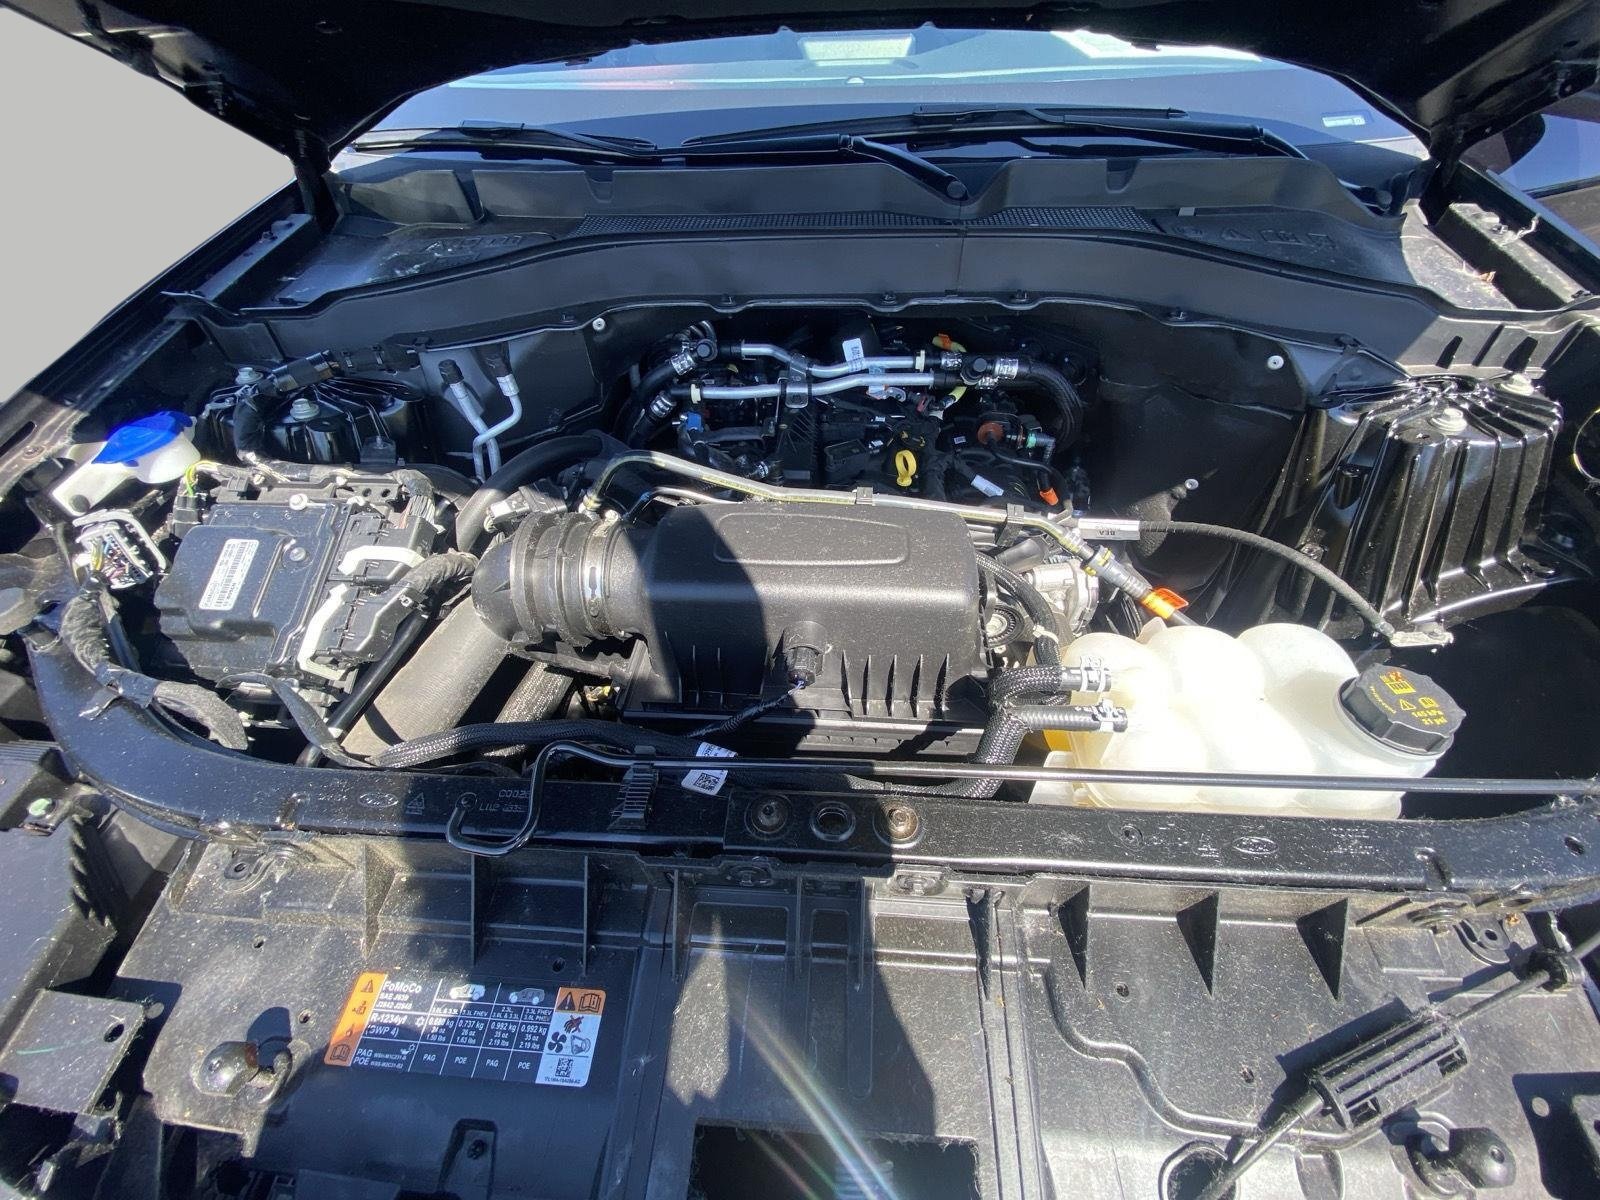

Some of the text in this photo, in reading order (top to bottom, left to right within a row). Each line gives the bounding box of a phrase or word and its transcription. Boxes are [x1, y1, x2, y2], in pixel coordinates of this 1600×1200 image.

[382, 980, 422, 993] FoMoCo
[370, 1013, 407, 1025] R-1234yf
[446, 1019, 454, 1028] kg
[459, 1020, 484, 1030] 0.737 kg
[491, 1022, 517, 1032] 0.992 kg
[521, 1024, 548, 1035] 0.992 kg
[357, 1049, 373, 1057] PAG
[354, 1056, 370, 1065] POE
[455, 1056, 467, 1064] POE
[486, 1059, 499, 1067] PAG
